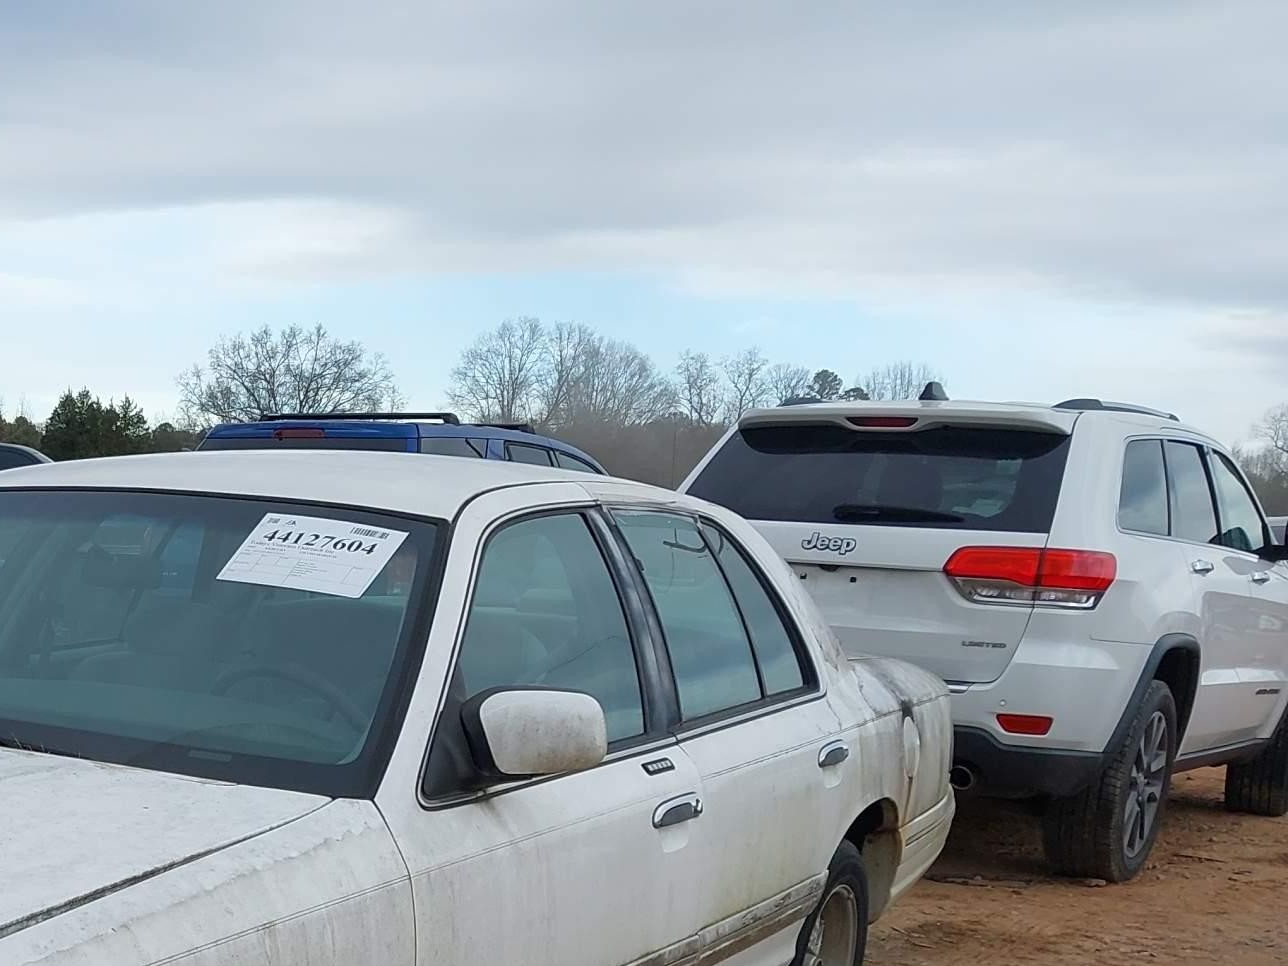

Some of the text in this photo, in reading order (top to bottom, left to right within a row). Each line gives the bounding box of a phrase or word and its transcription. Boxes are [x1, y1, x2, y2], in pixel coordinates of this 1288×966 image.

[263, 529, 379, 555] 44127604
[801, 531, 857, 555] Jeep
[961, 640, 1007, 649] LTED
